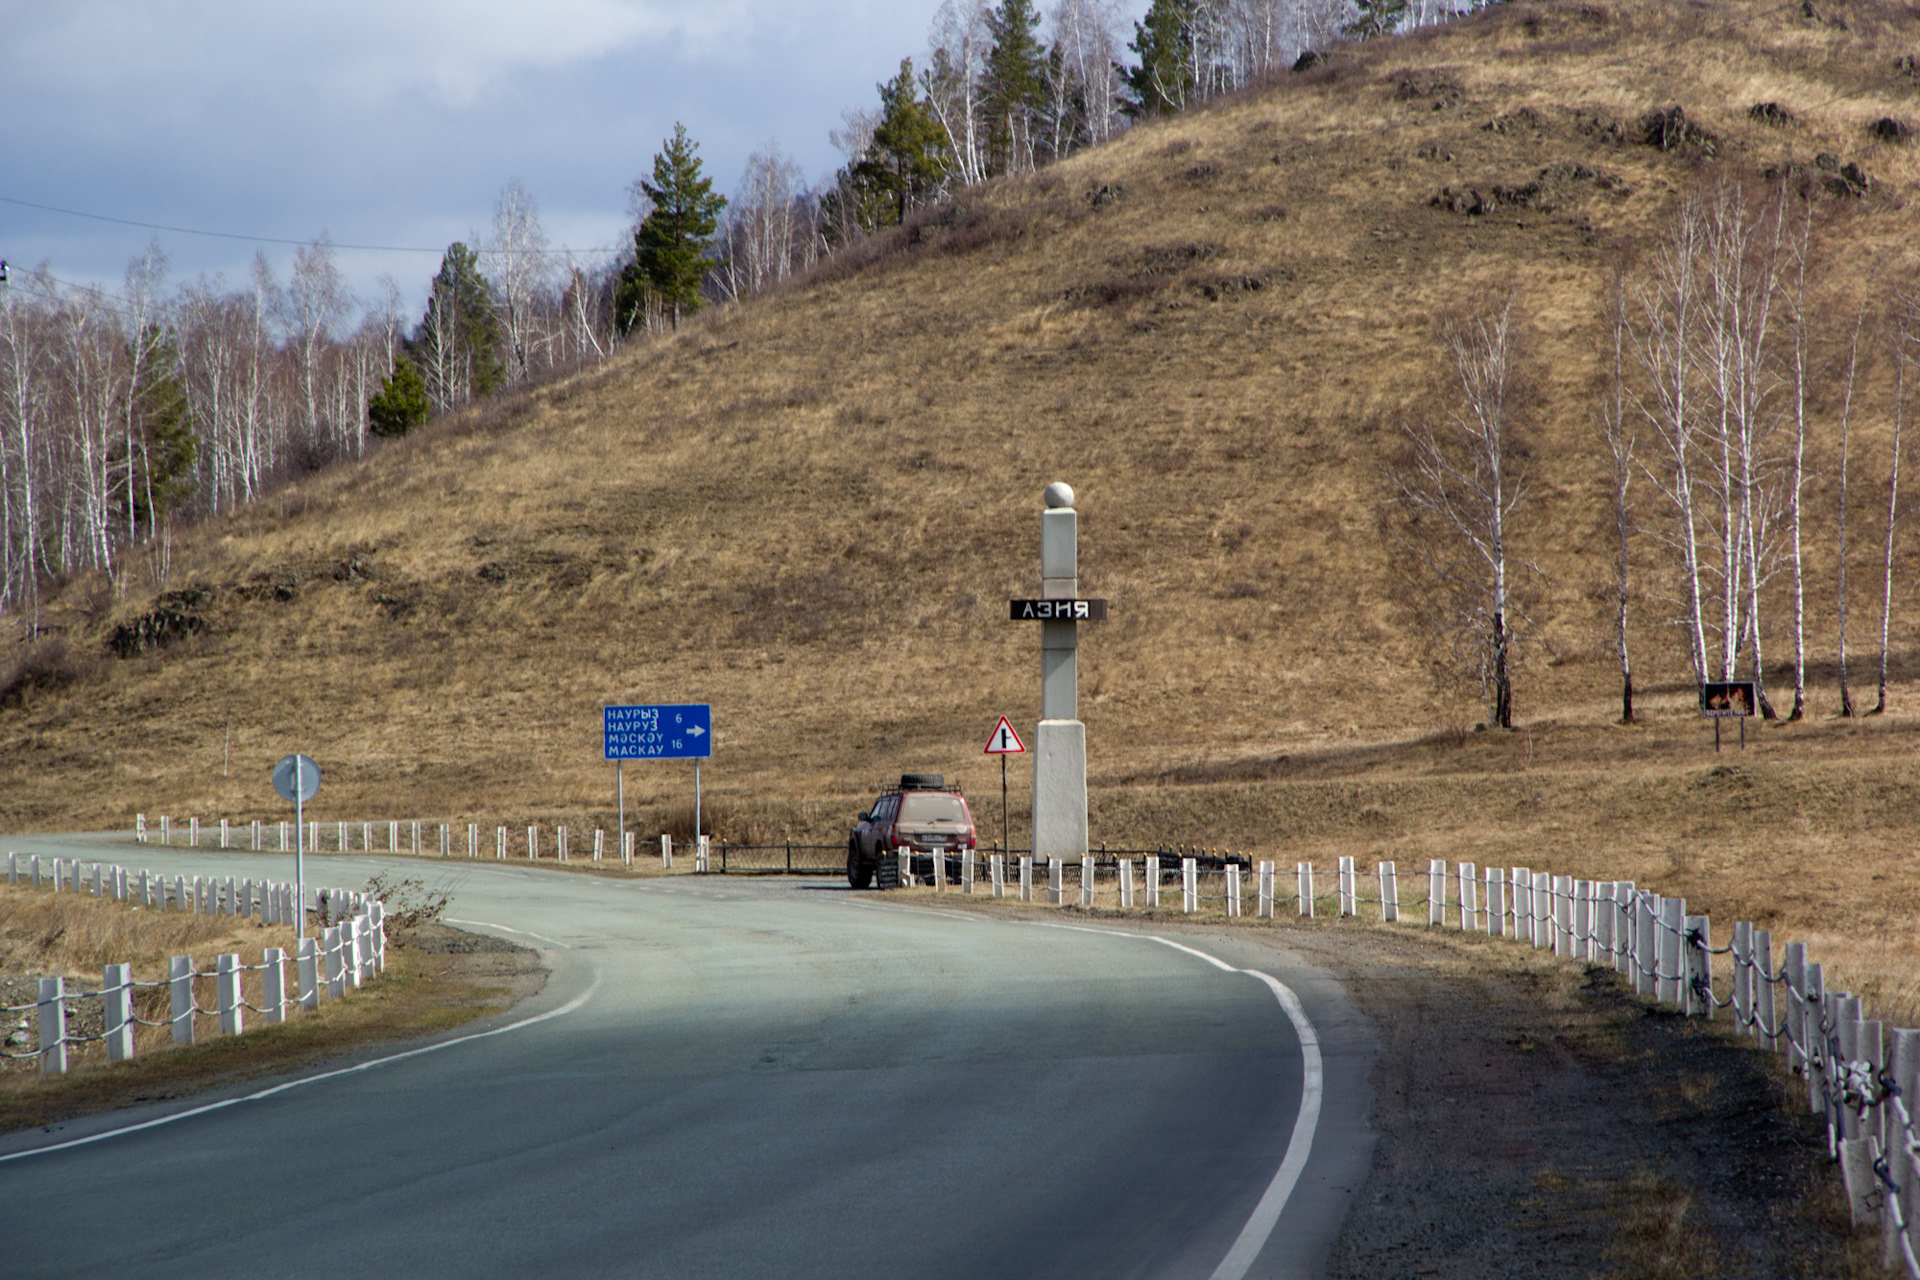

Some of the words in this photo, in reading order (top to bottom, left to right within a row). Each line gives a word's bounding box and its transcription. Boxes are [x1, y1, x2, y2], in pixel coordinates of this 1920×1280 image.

[1022, 601, 1089, 618] АЗИЯ
[675, 713, 683, 724] 6
[608, 721, 658, 732] НАУРУЗ
[672, 739, 683, 749] 16
[608, 745, 664, 756] МАСКАУ
